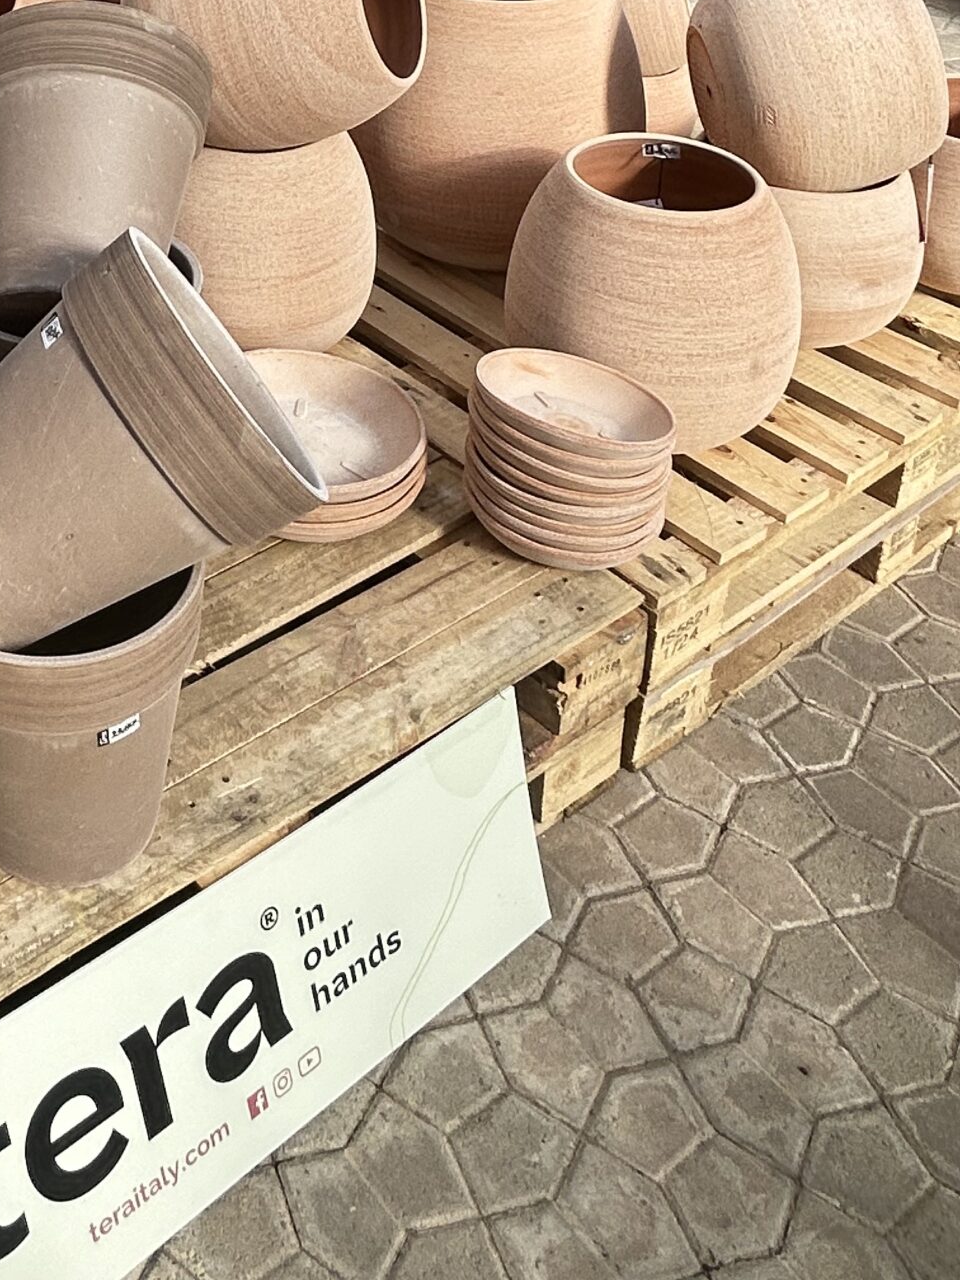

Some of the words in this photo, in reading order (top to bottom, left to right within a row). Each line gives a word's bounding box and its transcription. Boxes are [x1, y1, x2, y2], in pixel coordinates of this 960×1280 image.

[293, 900, 325, 937] in
[302, 918, 354, 971] our
[310, 929, 403, 1013] hands
[88, 1120, 231, 1244] teraitaly.com
